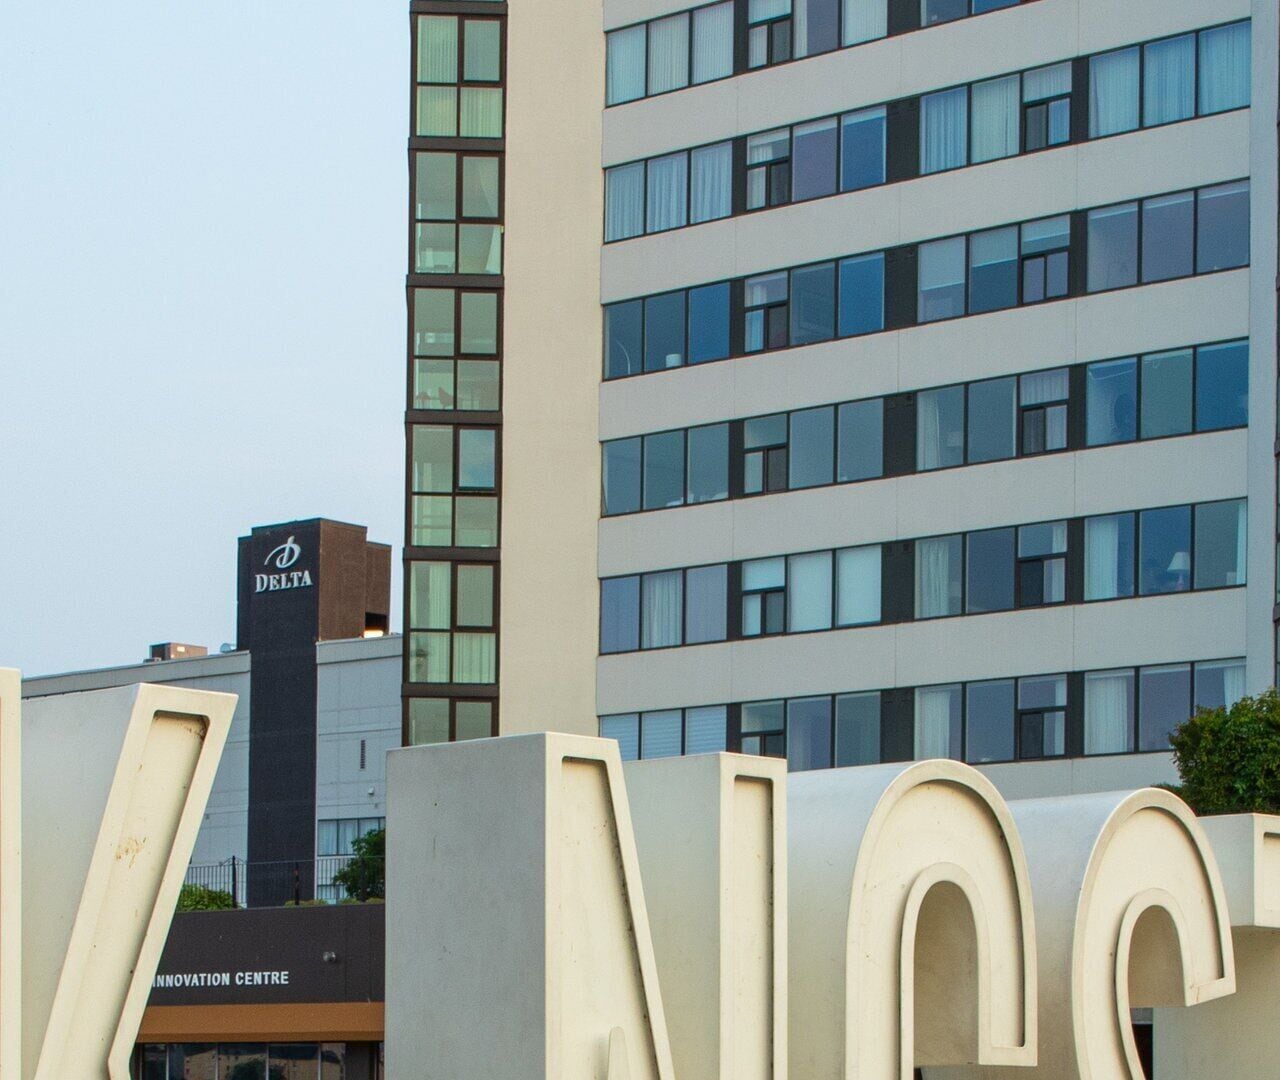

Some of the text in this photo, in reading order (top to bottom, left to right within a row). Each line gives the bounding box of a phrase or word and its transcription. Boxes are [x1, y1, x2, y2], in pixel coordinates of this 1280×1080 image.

[255, 570, 313, 593] DELTA
[152, 971, 289, 988] INNOVATION CENTRE
